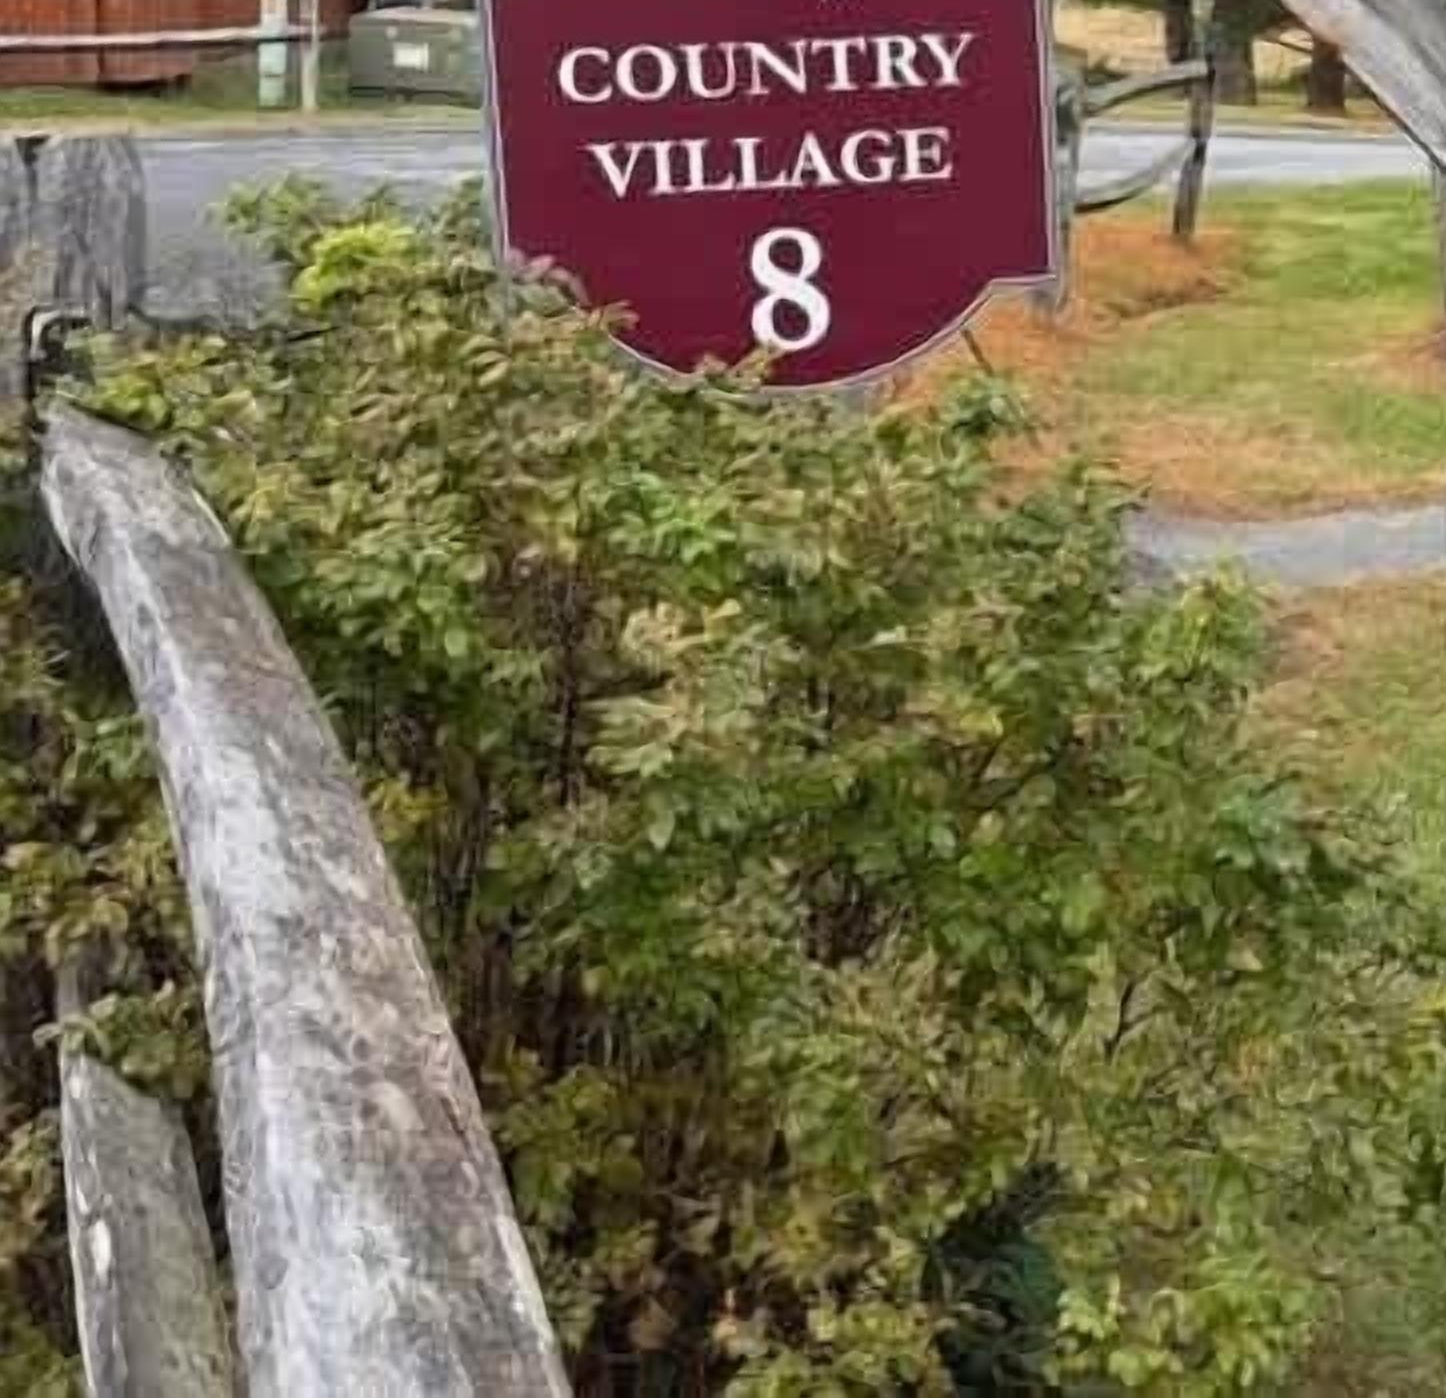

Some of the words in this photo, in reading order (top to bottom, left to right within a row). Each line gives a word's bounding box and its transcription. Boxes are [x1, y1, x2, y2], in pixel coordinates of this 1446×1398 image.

[557, 32, 974, 103] COUNTRY
[586, 126, 953, 198] VILLAGE
[750, 226, 830, 352] 8
